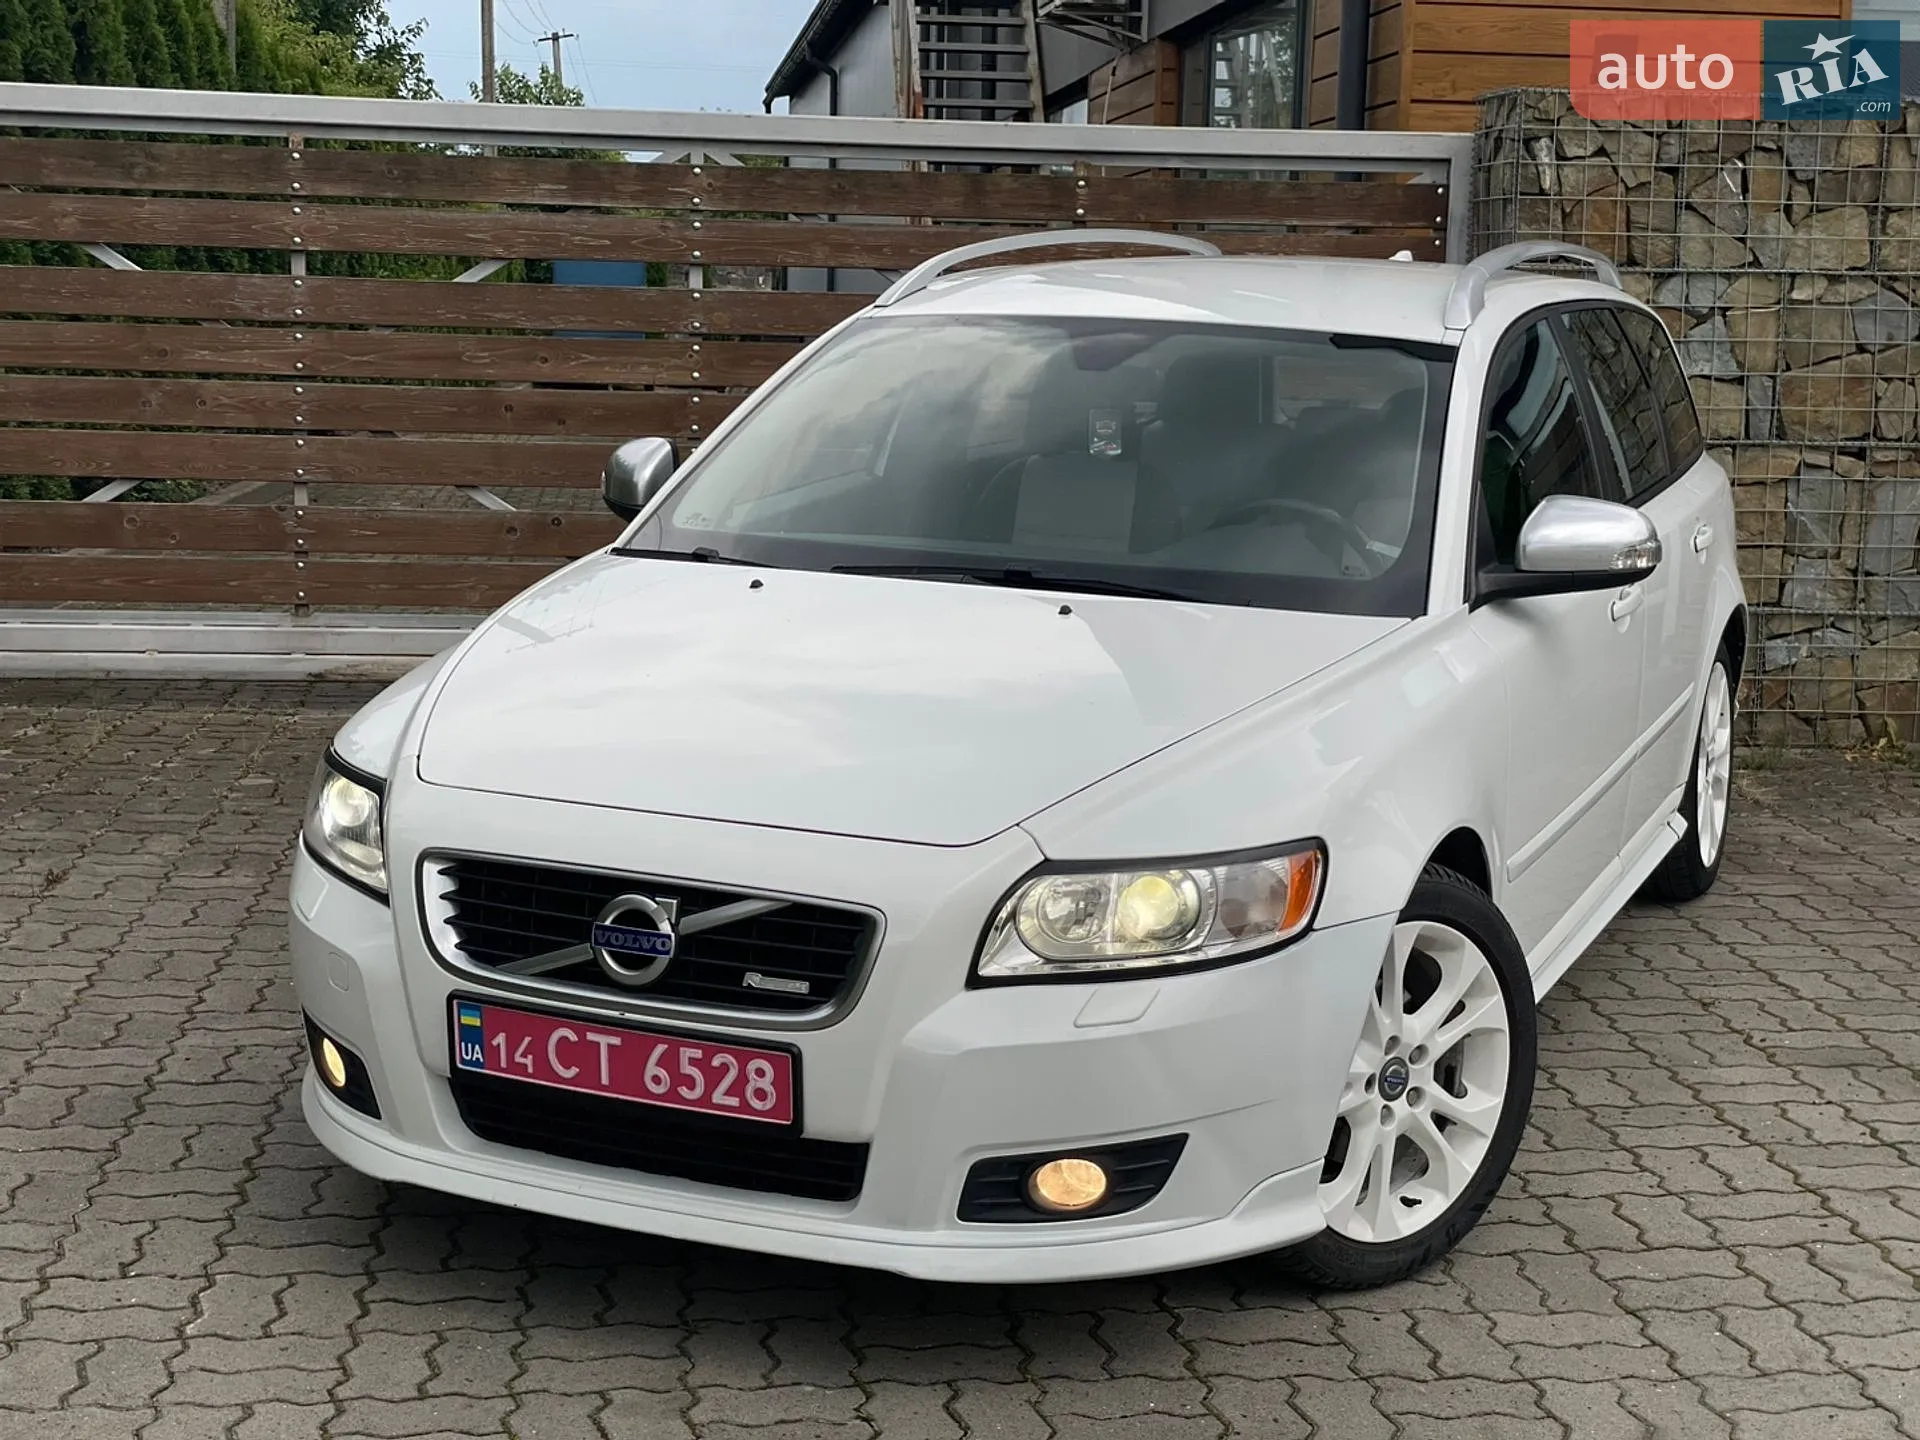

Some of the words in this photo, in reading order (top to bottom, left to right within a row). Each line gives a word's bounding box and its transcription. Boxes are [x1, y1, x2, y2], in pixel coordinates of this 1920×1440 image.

[594, 930, 672, 951] VOLVO
[461, 1041, 484, 1063] UA
[491, 1032, 533, 1074] 14
[547, 1028, 621, 1086] CT
[644, 1043, 776, 1111] 6528
